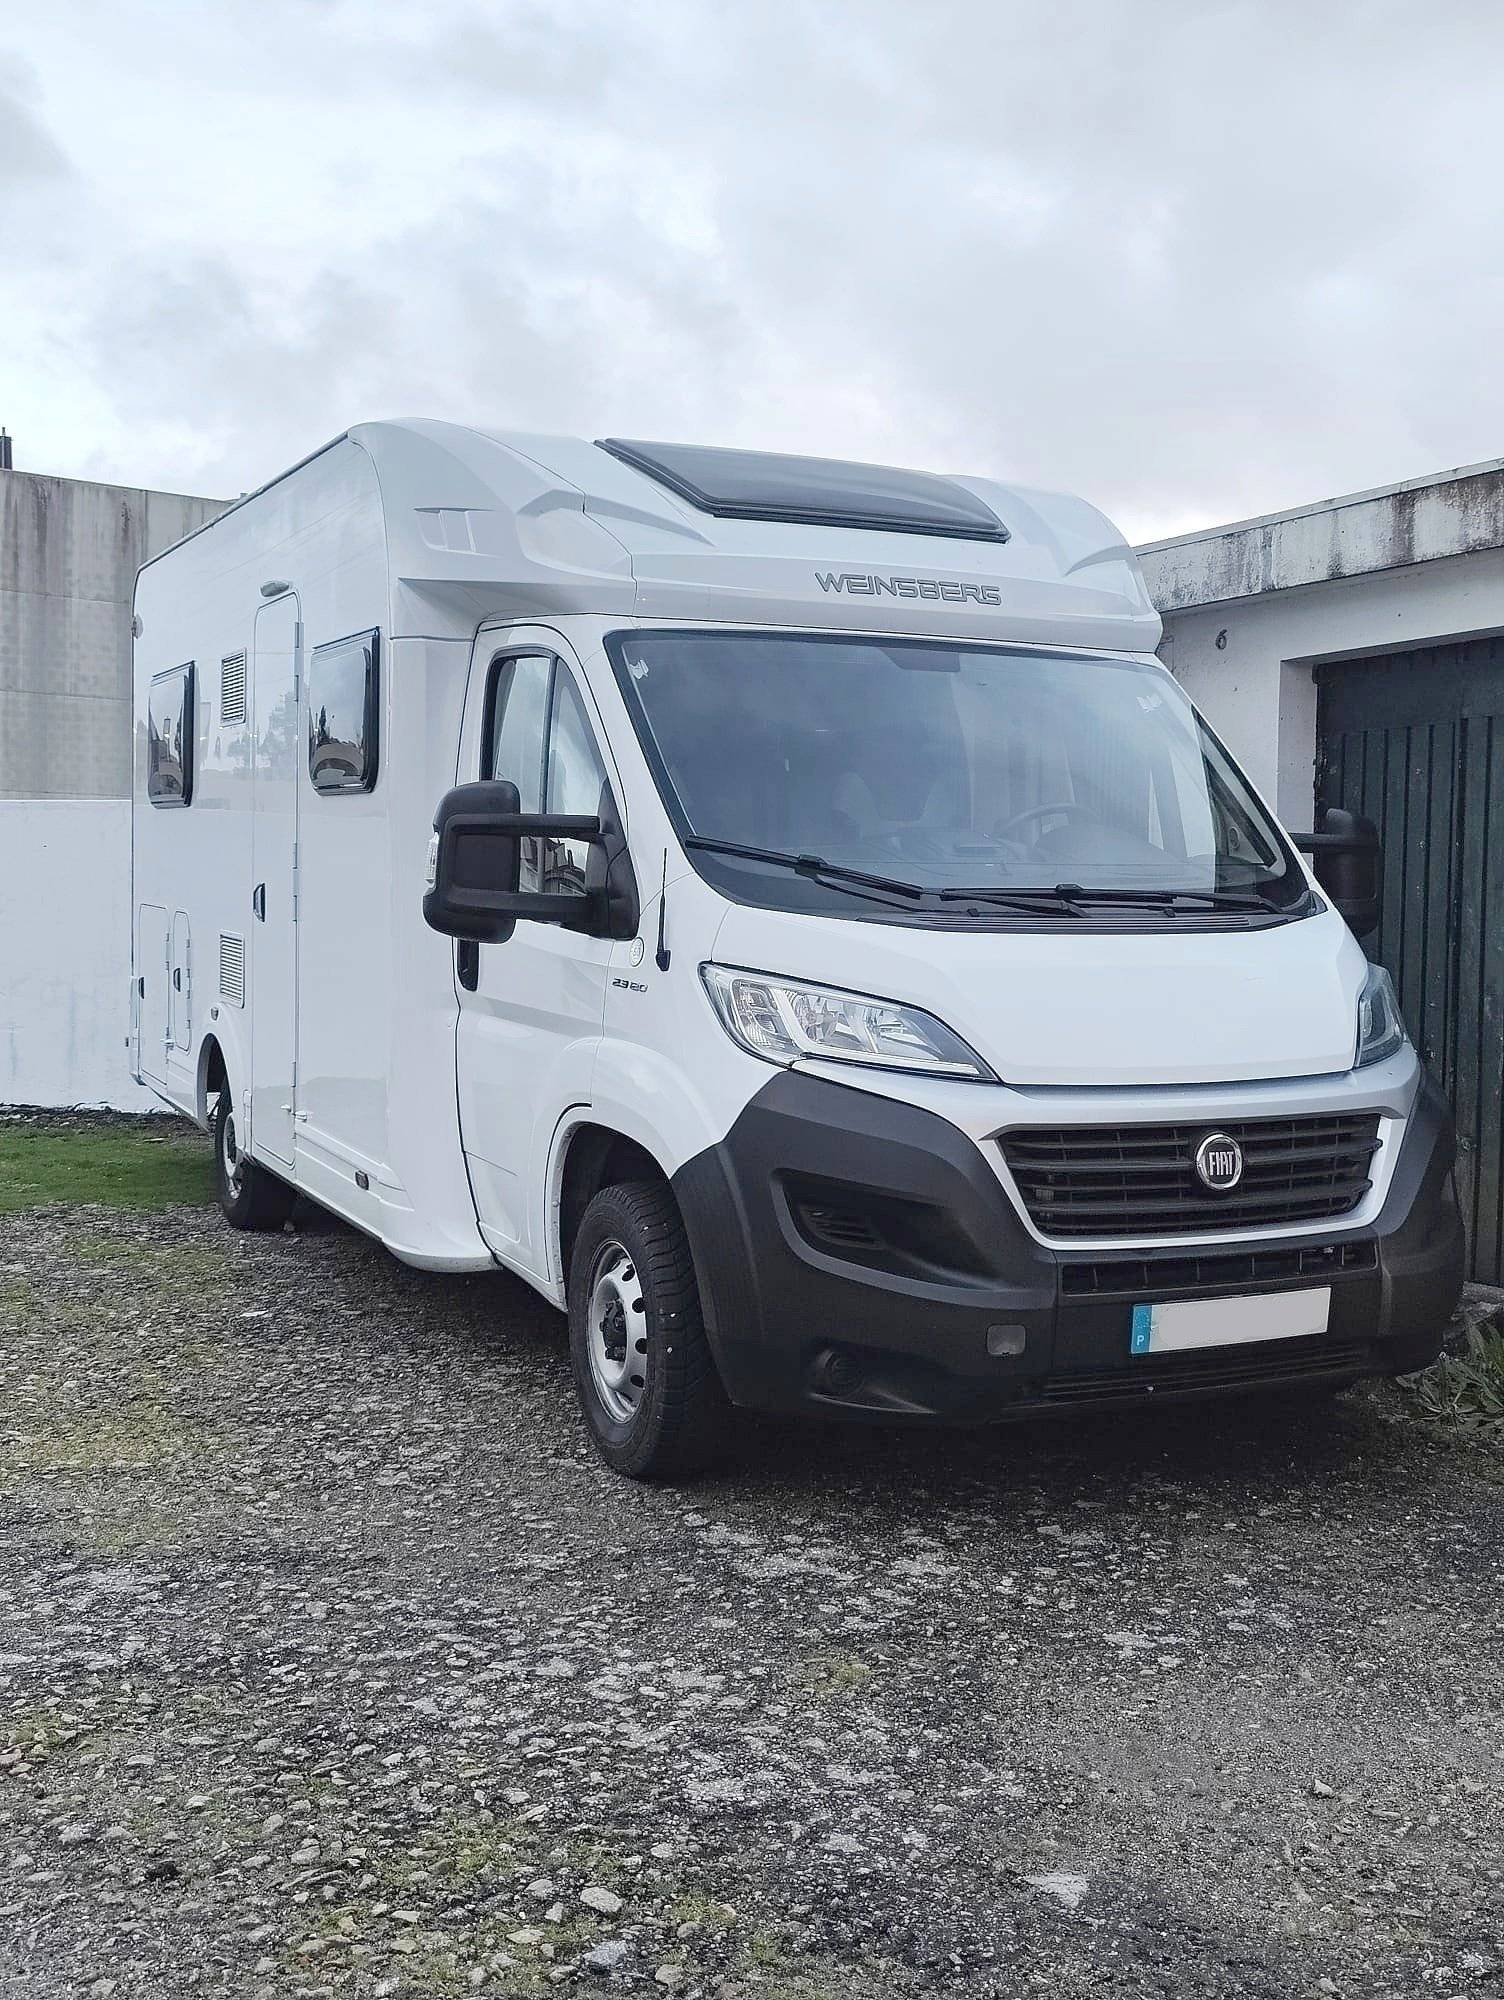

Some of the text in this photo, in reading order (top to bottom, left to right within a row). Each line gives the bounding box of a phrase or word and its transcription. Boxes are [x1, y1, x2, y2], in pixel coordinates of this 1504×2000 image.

[815, 572, 1001, 605] WEINSBERG
[1215, 629, 1227, 650] 6
[1209, 1151, 1234, 1176] FIAT
[1136, 1334, 1145, 1346] P
